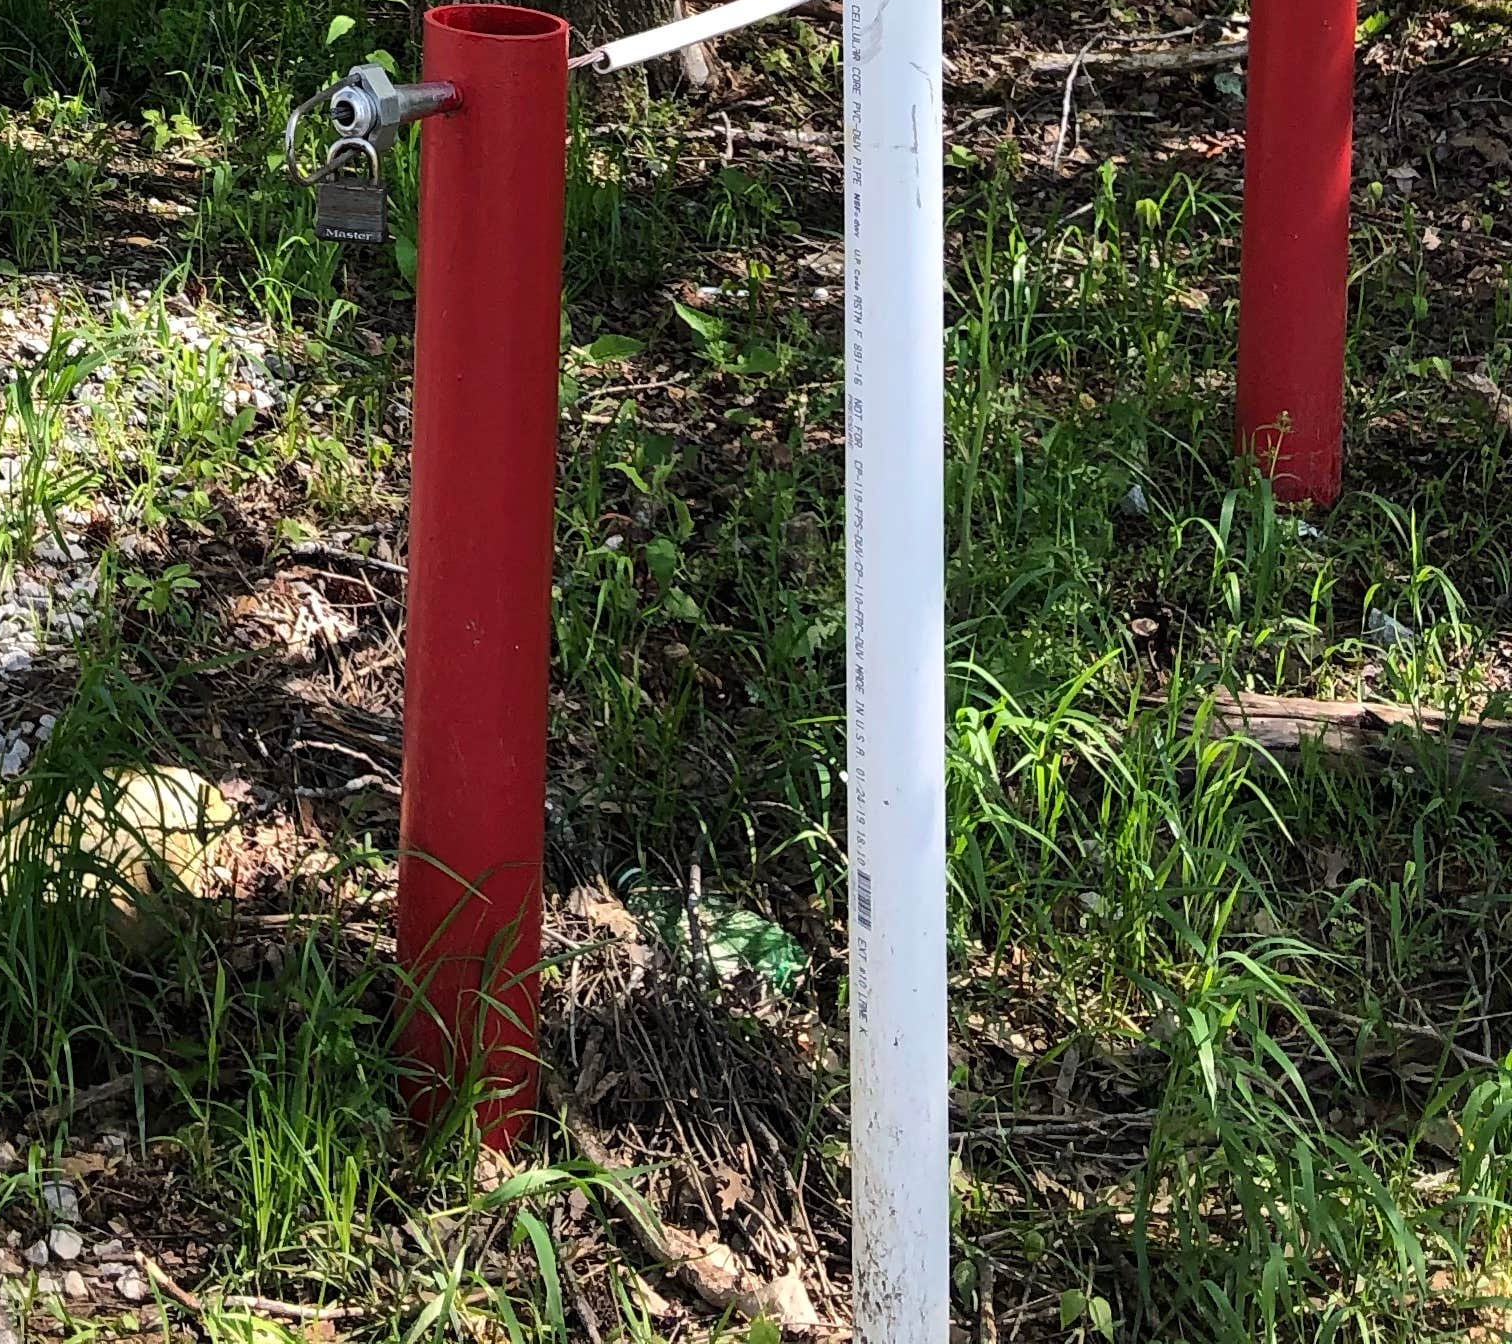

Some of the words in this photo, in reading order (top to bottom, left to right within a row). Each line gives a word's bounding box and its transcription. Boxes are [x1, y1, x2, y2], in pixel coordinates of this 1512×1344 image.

[851, 5, 861, 61] CELLULAR
[852, 67, 862, 95] CORE
[852, 157, 862, 185] PIPE
[325, 228, 373, 241] Master
[854, 295, 862, 325] ASTM
[854, 329, 863, 339] F
[854, 343, 863, 386] 891-16
[854, 397, 863, 421] NOT
[854, 425, 863, 449] FOR
[855, 664, 864, 695] MADE
[855, 700, 865, 716] IN
